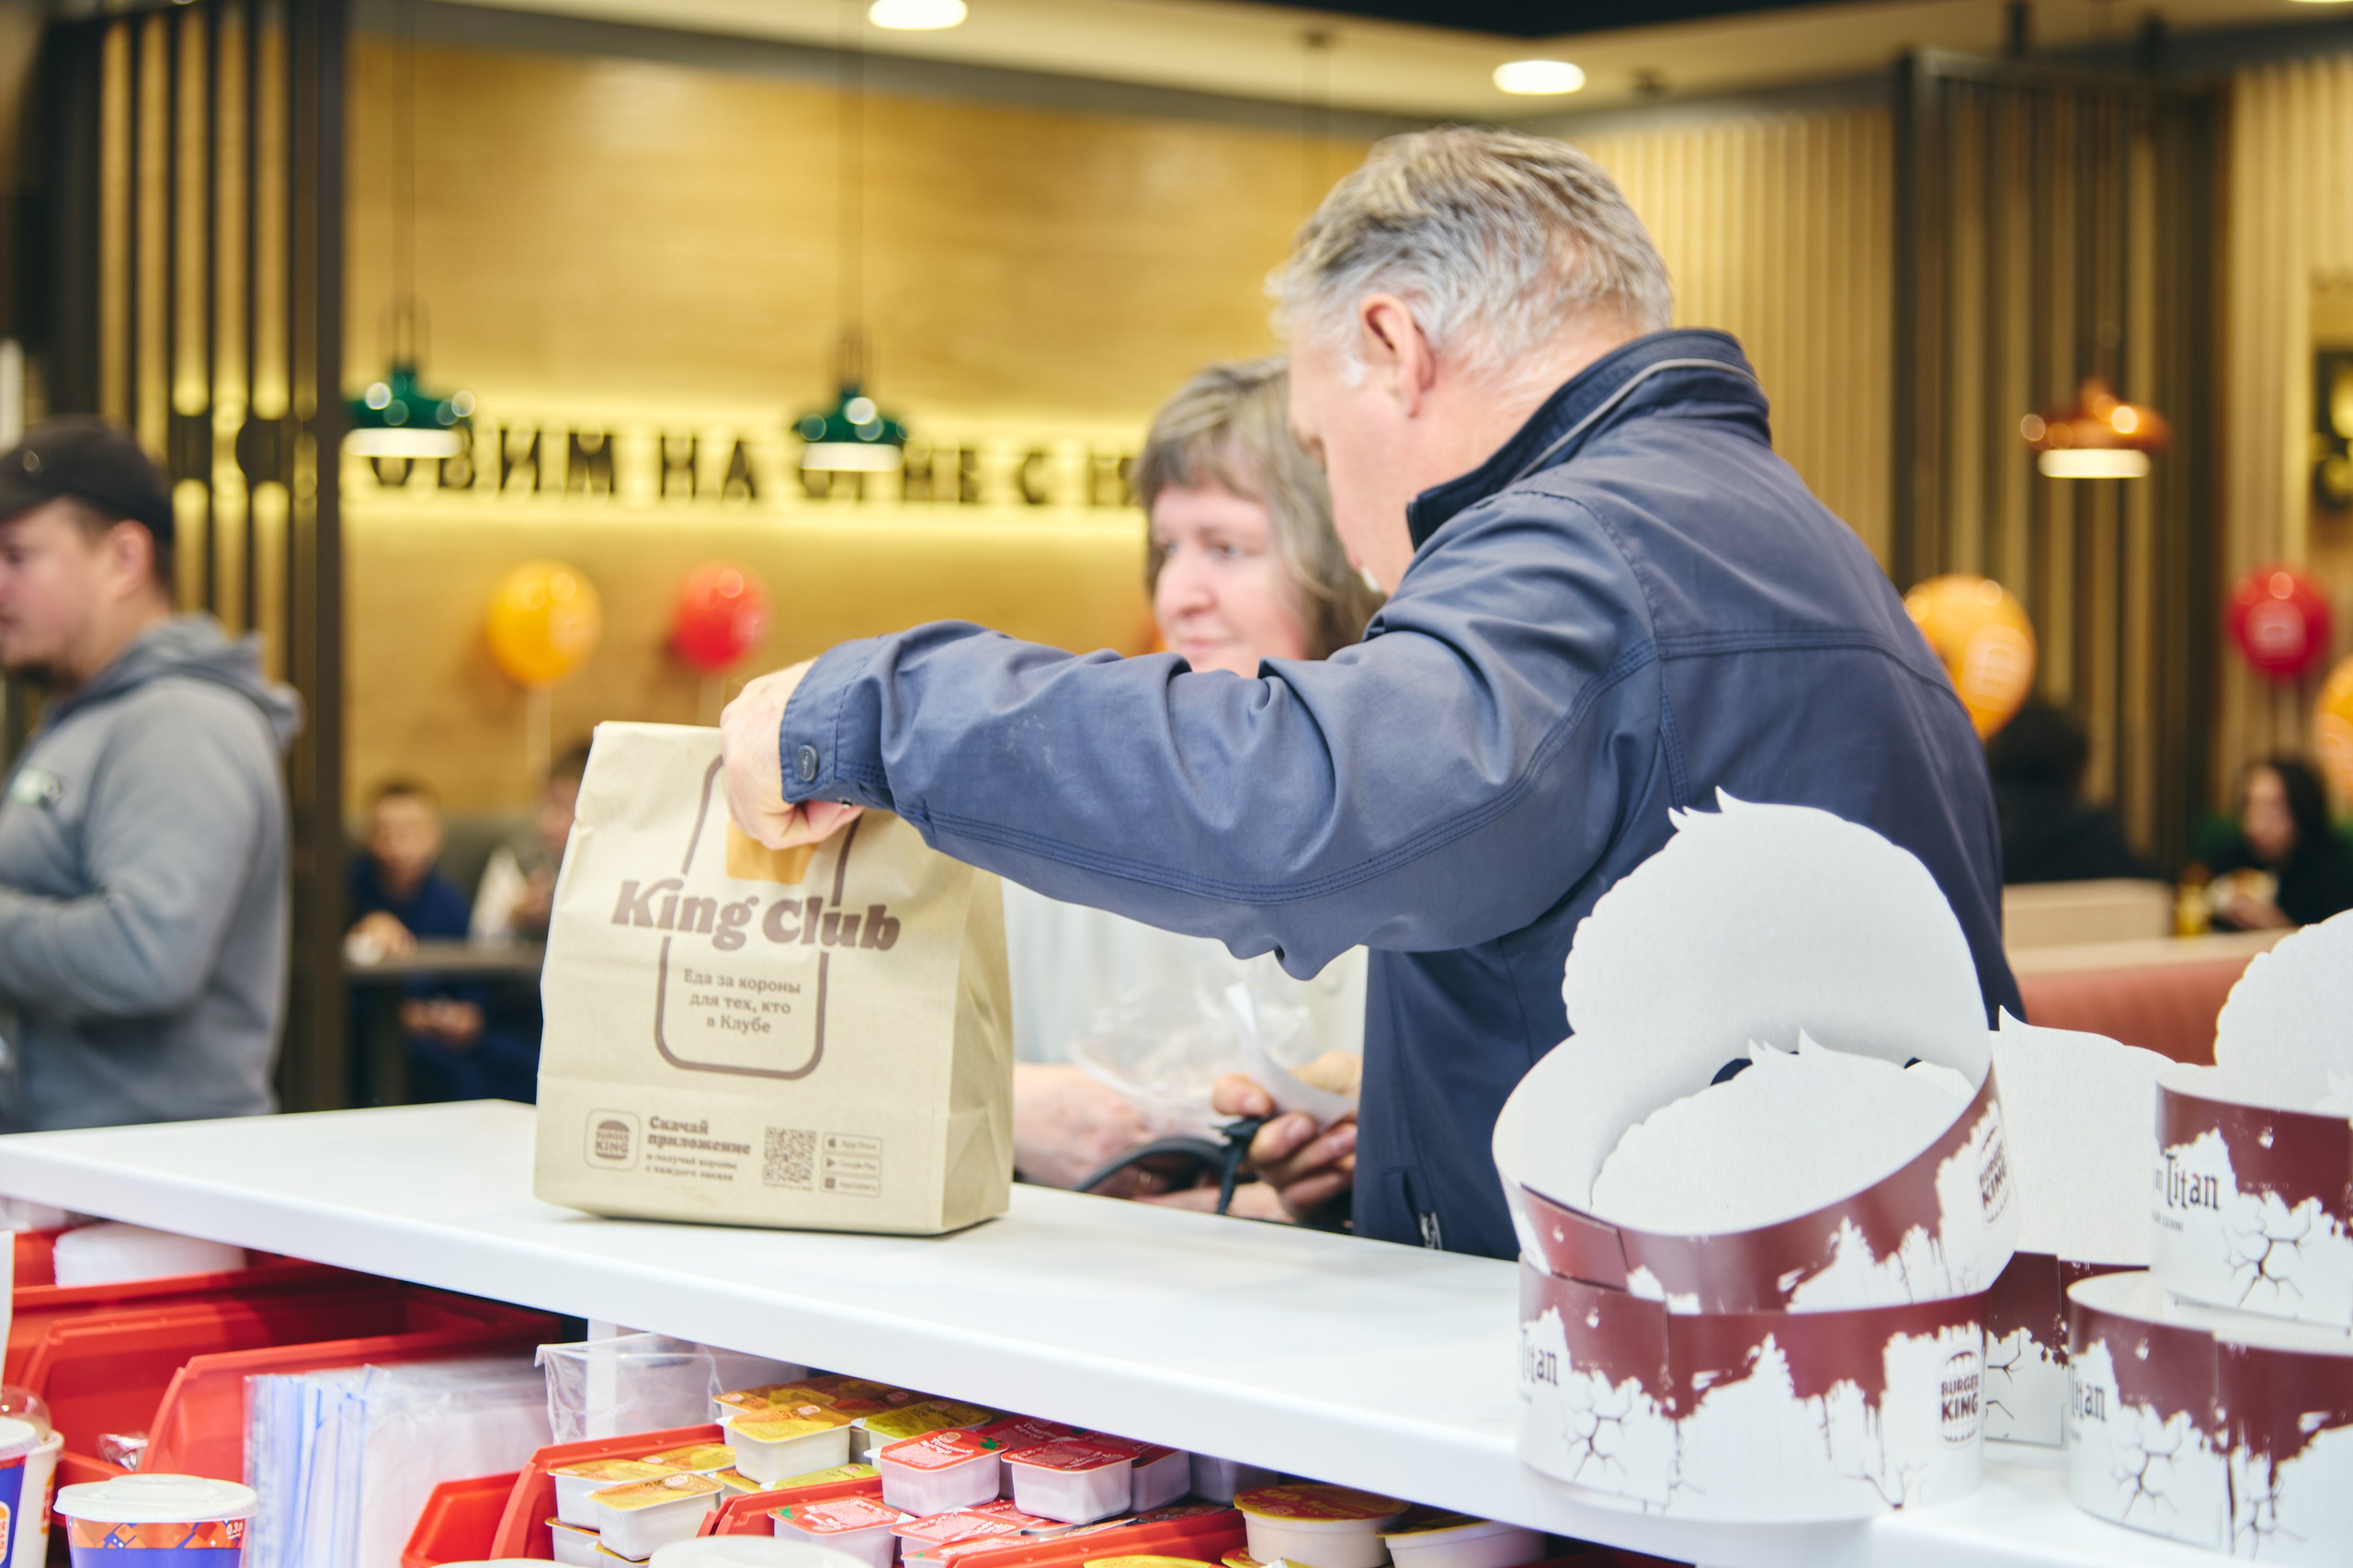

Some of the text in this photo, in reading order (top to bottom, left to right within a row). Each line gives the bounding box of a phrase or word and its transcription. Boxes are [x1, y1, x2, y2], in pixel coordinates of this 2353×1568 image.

[611, 879, 902, 951] King Club
[683, 968, 801, 995] Еда за короны
[688, 993, 791, 1015] для тех, кто
[706, 1015, 772, 1035] в Клубе
[648, 1115, 710, 1135] Скачай
[646, 1132, 752, 1156] приложение
[1982, 1156, 2007, 1211] KING
[2165, 1153, 2220, 1211] Titan
[1941, 1392, 1979, 1424] KING
